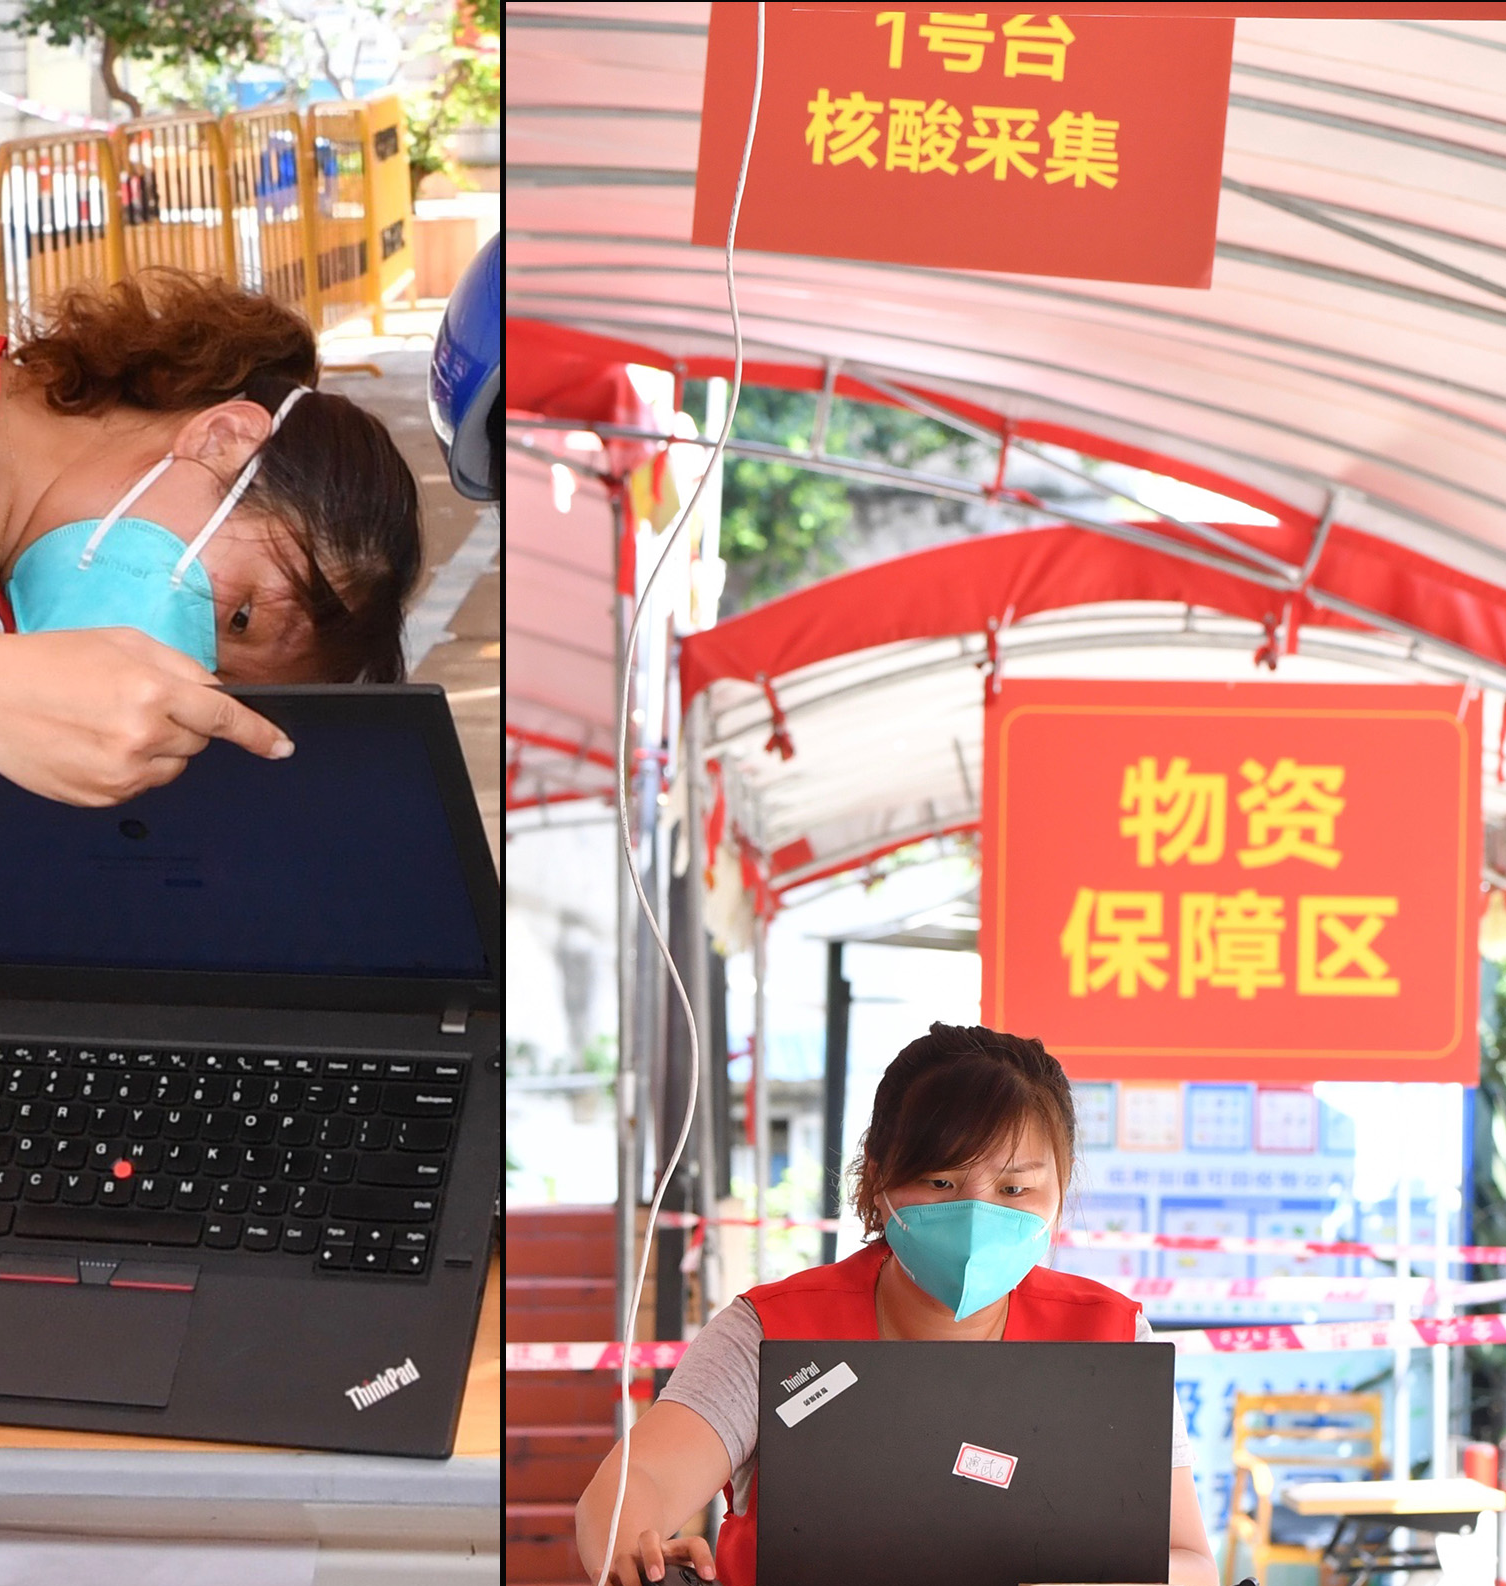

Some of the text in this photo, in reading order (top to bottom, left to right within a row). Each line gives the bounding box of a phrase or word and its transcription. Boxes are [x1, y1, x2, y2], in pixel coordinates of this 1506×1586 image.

[874, 12, 1077, 83] 1号台
[806, 88, 1121, 191] 核酸采集
[1121, 758, 1344, 868] 物资
[1061, 889, 1399, 998] 保障区
[8, 1081, 18, 1092] 3
[46, 1083, 55, 1093] 4
[83, 1084, 92, 1096] 5
[119, 1086, 128, 1097] 6
[157, 1087, 166, 1098] 7
[194, 1089, 203, 1100] 8
[232, 1091, 241, 1102] 9
[269, 1092, 279, 1104] 0
[20, 1104, 31, 1116] E
[57, 1106, 68, 1118] R
[96, 1108, 106, 1119] T
[133, 1109, 143, 1121] Y
[169, 1111, 181, 1123] U
[244, 1115, 257, 1127] O
[282, 1116, 294, 1128] P
[20, 1138, 32, 1150] D
[57, 1140, 68, 1152] F
[95, 1142, 107, 1155] G
[132, 1144, 144, 1156] H
[169, 1146, 180, 1158] J
[207, 1148, 218, 1159] K
[245, 1149, 255, 1162] L
[30, 1173, 42, 1185] C
[68, 1175, 79, 1187] V
[103, 1181, 115, 1193] B
[141, 1179, 154, 1191] N
[180, 1181, 194, 1193] M
[345, 1357, 421, 1411] ThinkPad
[780, 1361, 821, 1393] ThinkPad
